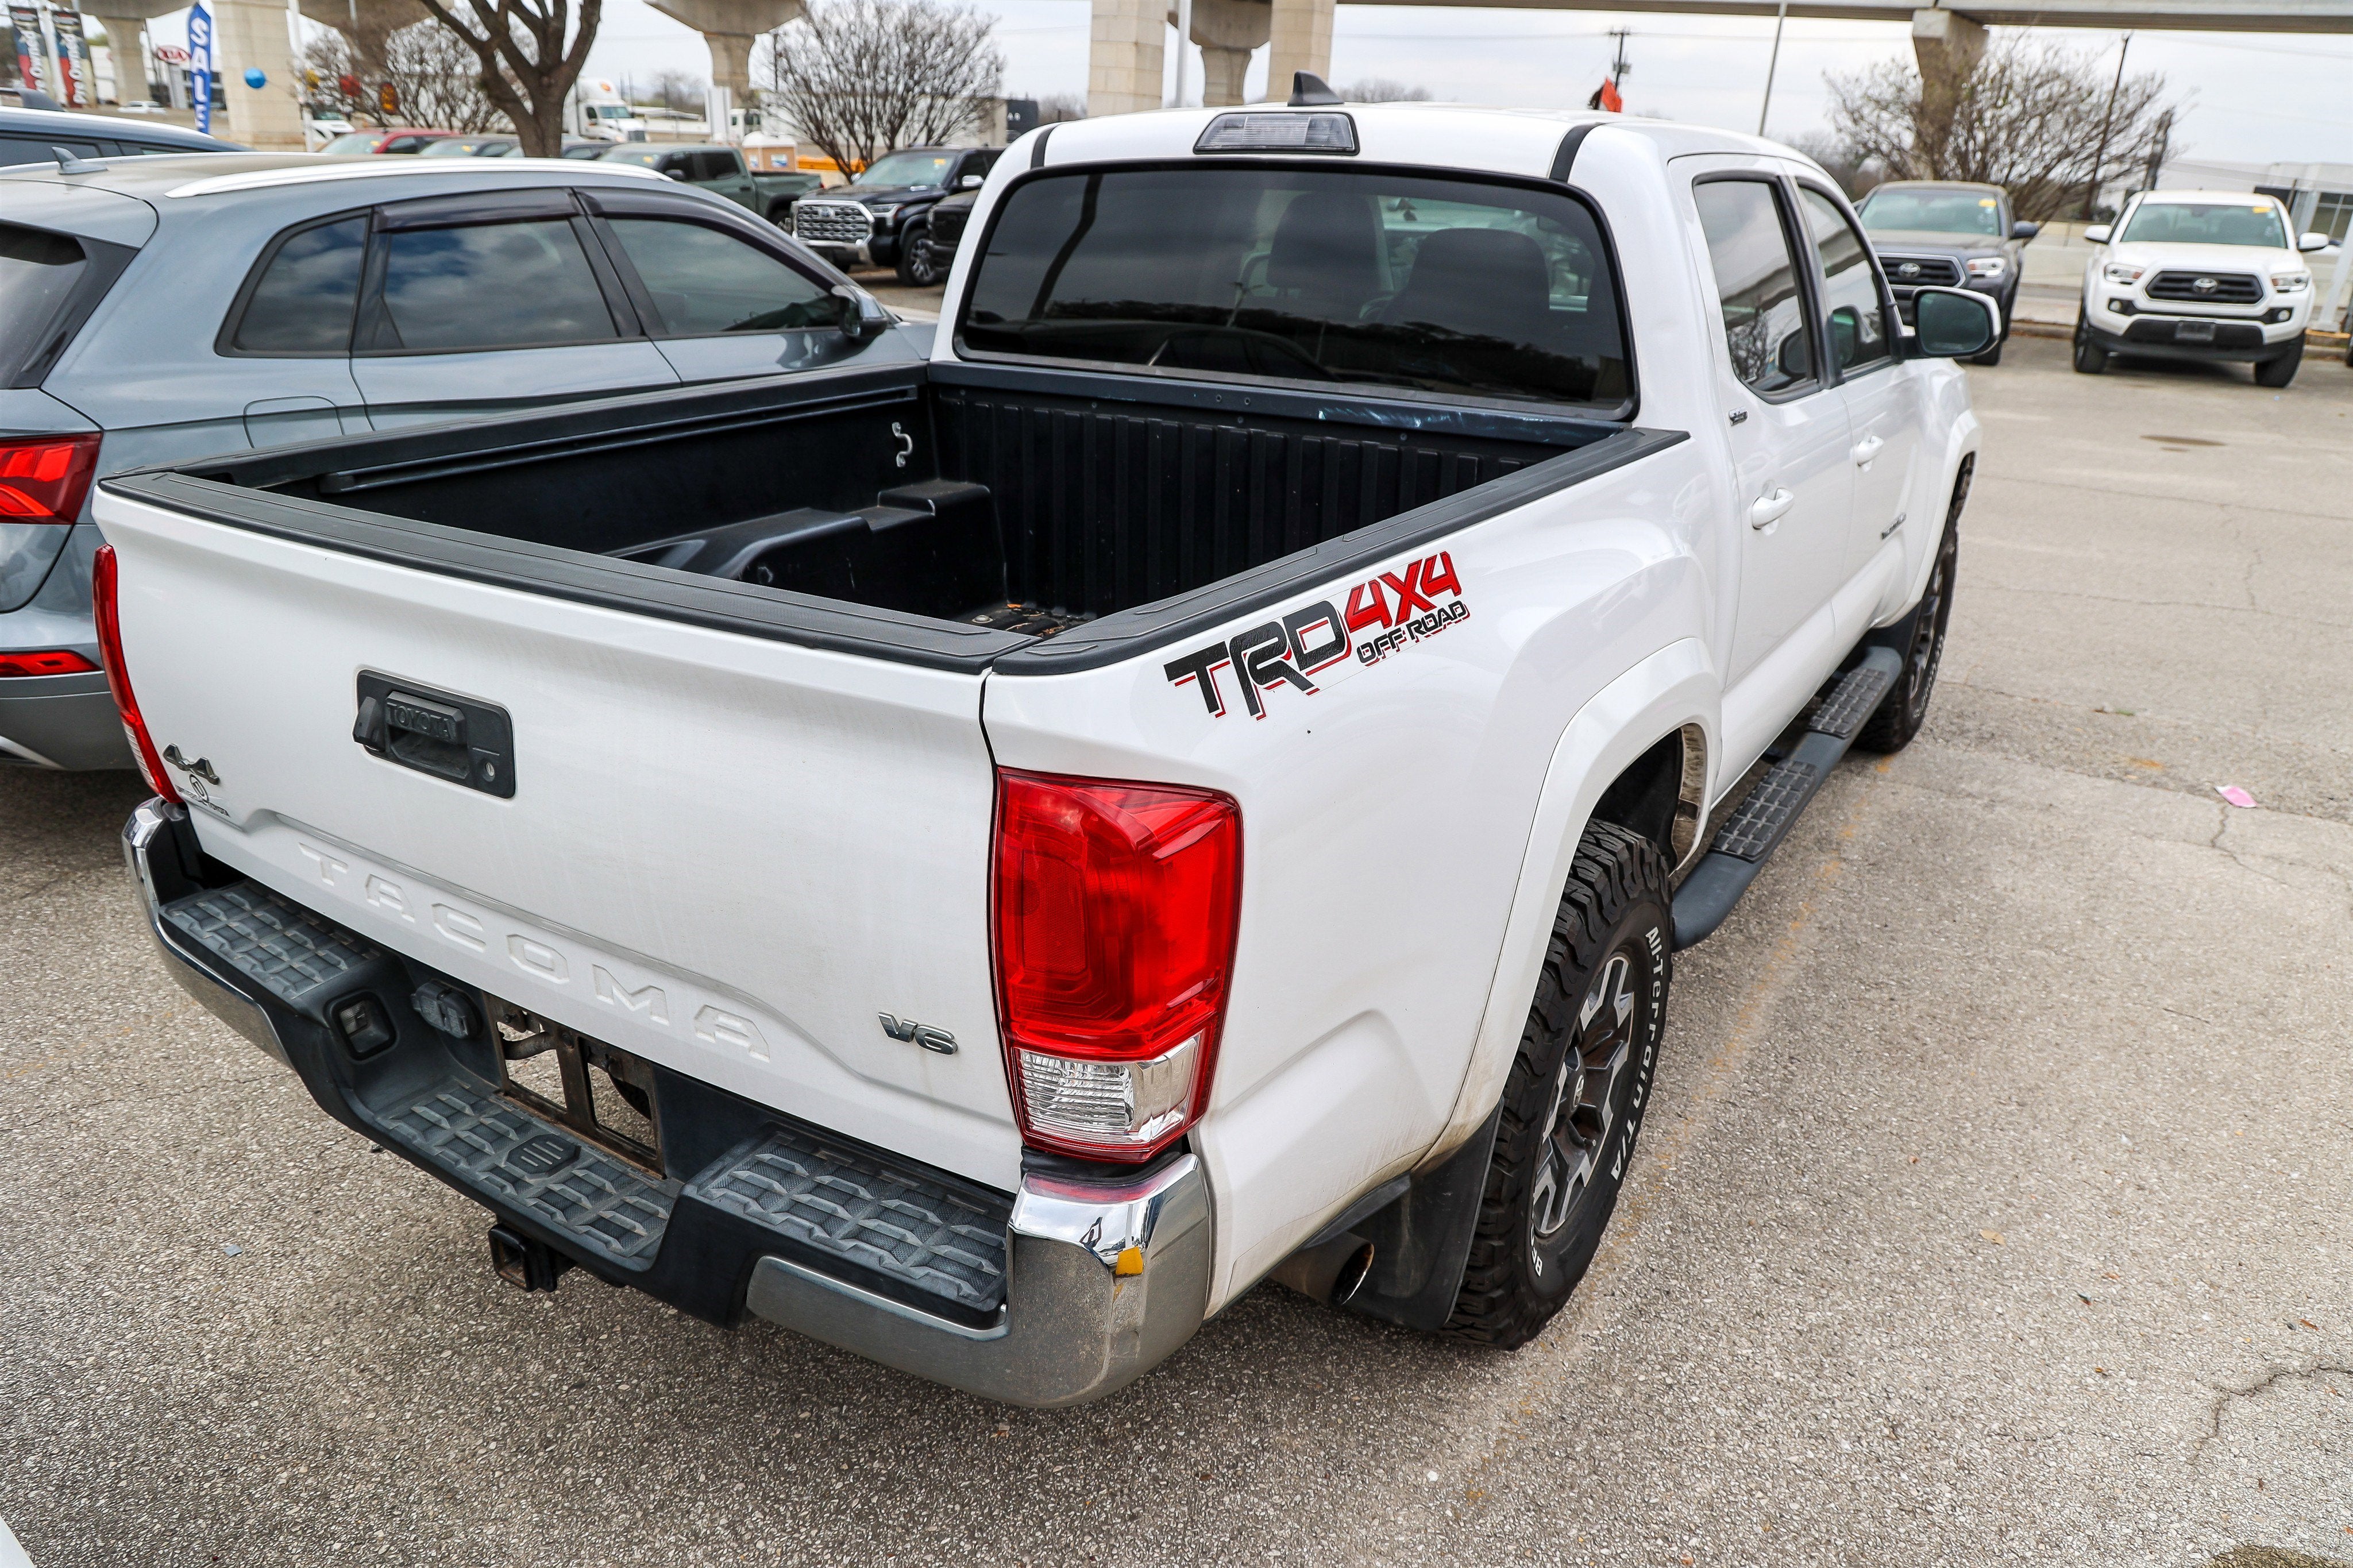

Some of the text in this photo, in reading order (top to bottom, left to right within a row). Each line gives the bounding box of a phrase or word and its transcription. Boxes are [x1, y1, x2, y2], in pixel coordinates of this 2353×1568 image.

[190, 17, 210, 129] SALE
[1163, 551, 1461, 720] TRD 4X4
[1356, 600, 1470, 666] OFF ROAD
[386, 701, 457, 740] TOYOTA
[299, 843, 771, 1063] TACOMA
[878, 1012, 958, 1055] V6
[1610, 926, 1664, 1181] All-Terrain T/A
